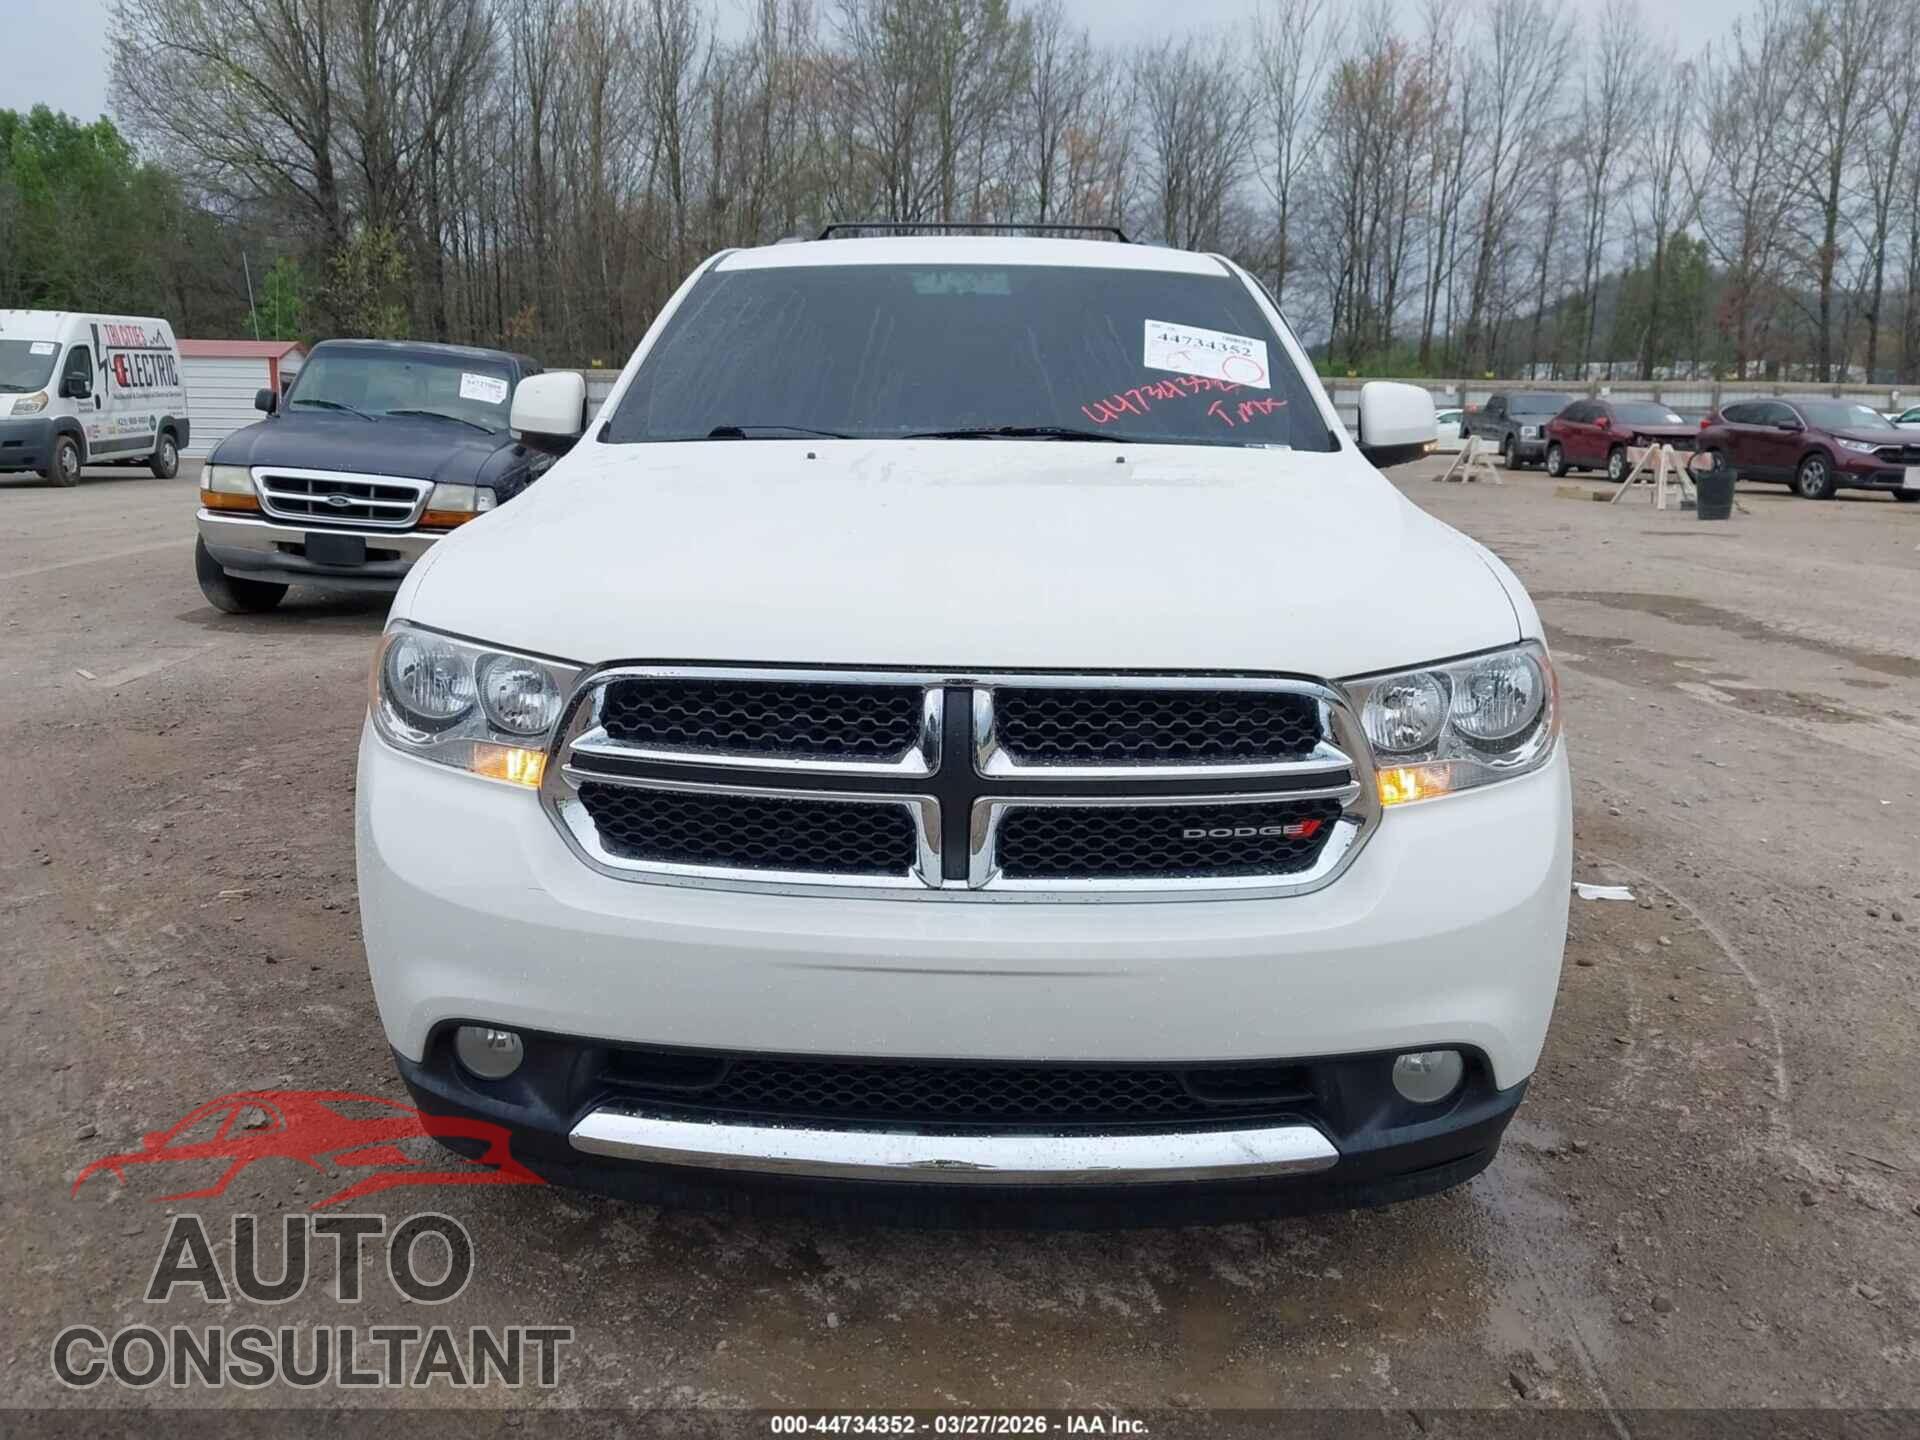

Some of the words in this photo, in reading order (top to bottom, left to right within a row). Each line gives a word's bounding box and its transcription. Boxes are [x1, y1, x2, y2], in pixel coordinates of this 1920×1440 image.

[1158, 333, 1253, 357] 44734352
[113, 353, 179, 388] ELECTRIC
[1183, 824, 1304, 839] DODGE
